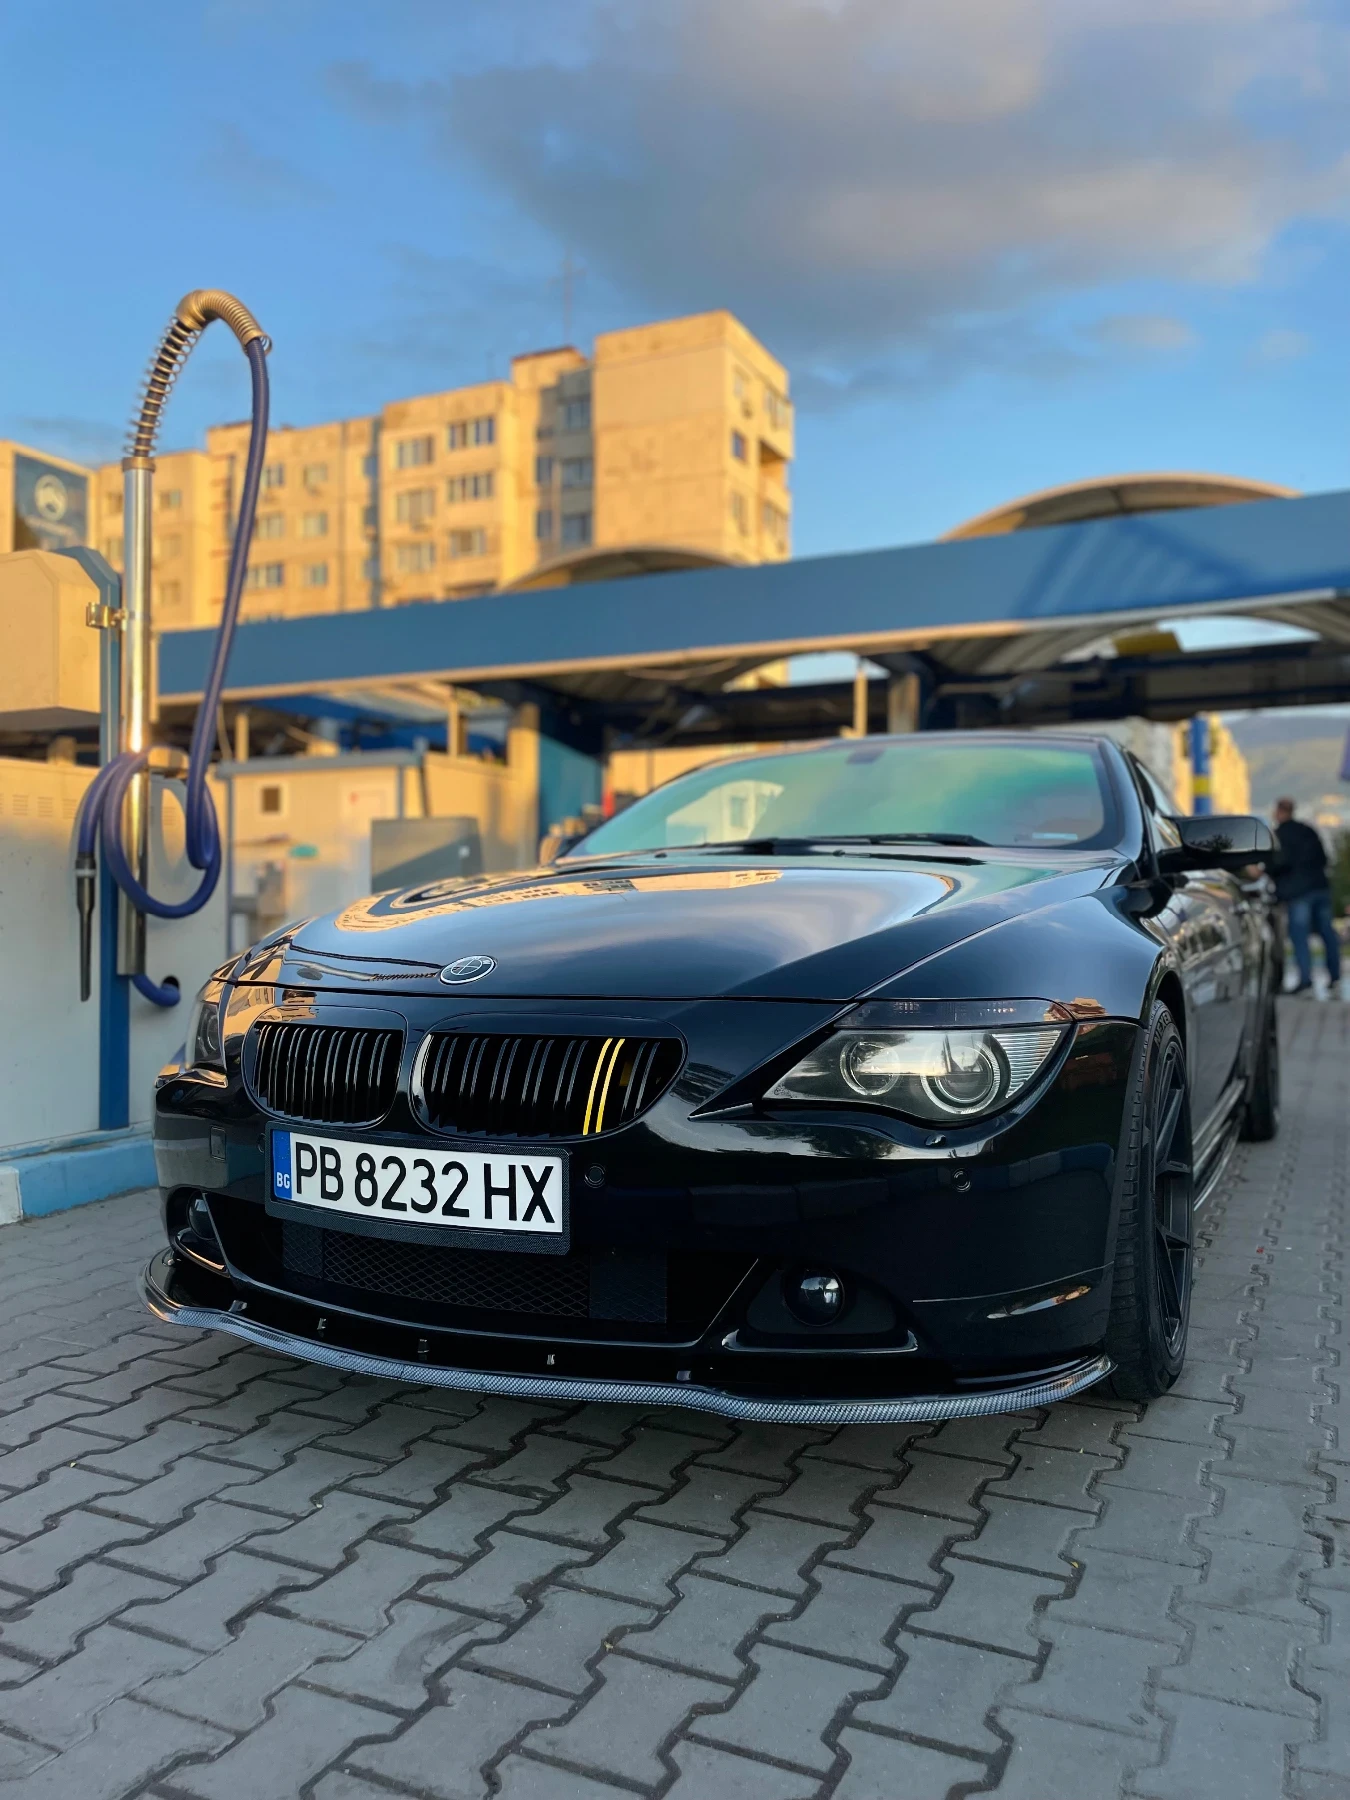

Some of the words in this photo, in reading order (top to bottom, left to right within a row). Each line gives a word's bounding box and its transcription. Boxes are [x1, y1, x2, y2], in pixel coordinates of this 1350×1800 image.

[1153, 1010, 1172, 1048] NEXE
[276, 1172, 290, 1189] BG
[295, 1141, 344, 1201] PB
[354, 1152, 470, 1218] 8232
[483, 1162, 556, 1224] HX
